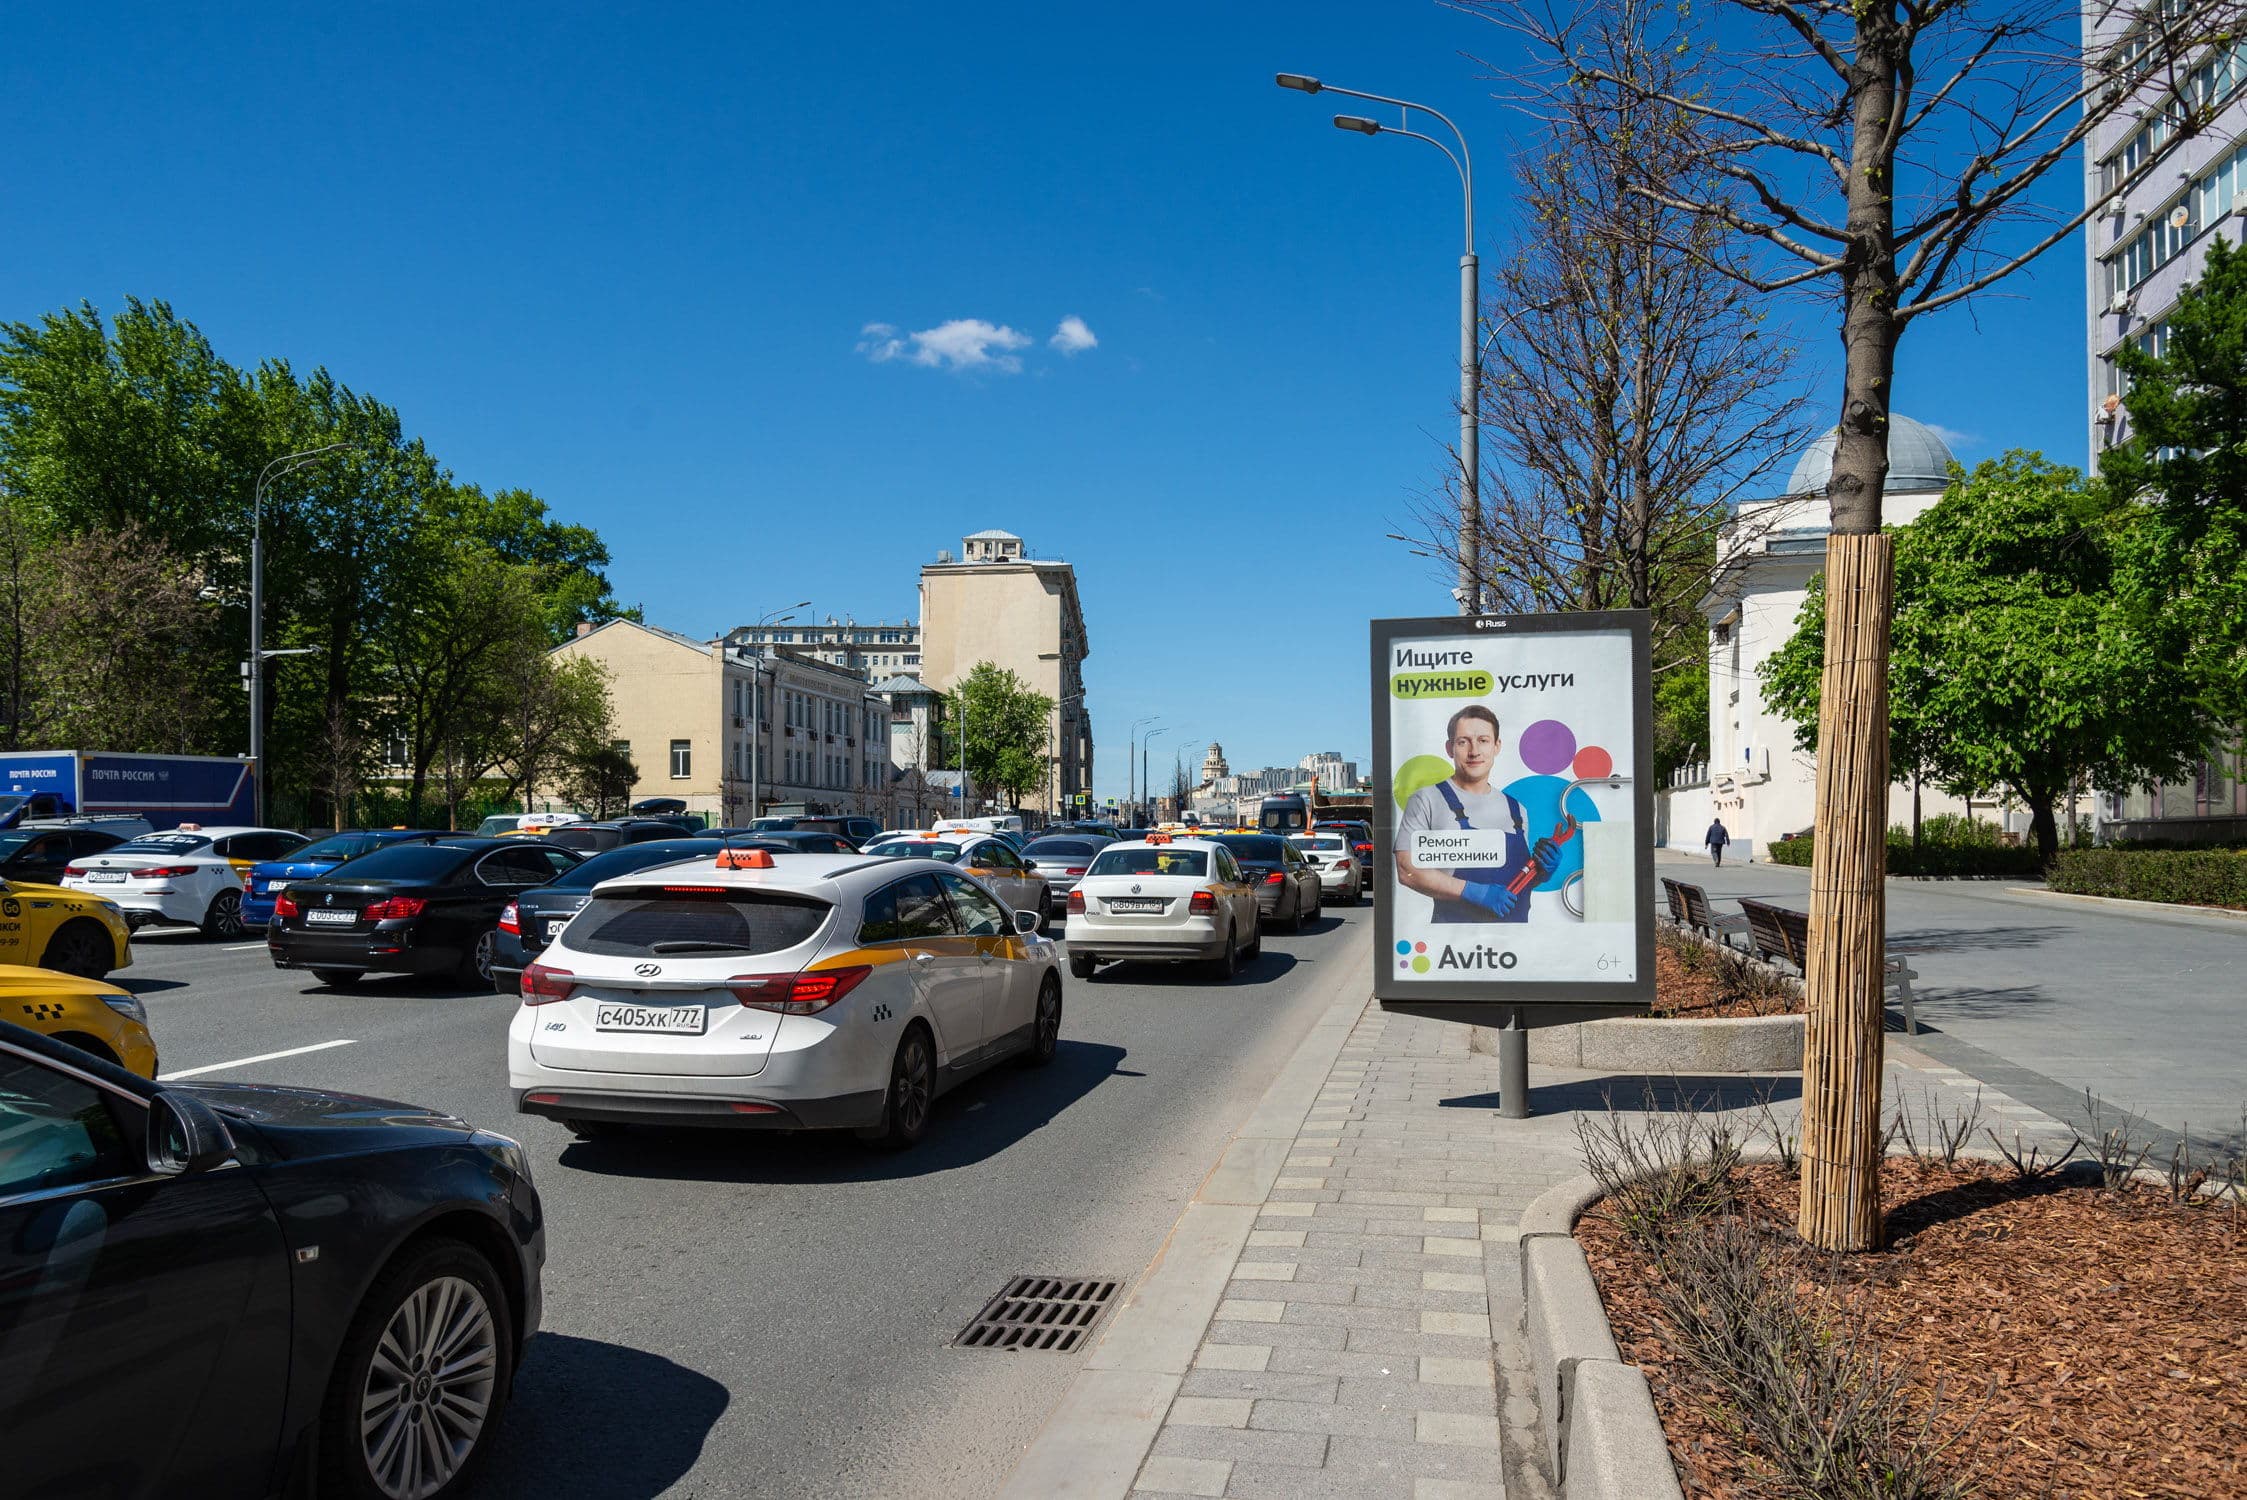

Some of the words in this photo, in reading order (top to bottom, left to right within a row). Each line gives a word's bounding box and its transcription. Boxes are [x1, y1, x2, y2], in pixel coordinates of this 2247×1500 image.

[1485, 619, 1507, 628] Russ
[1396, 648, 1473, 669] Ищите
[1396, 675, 1487, 696] нужные
[1498, 672, 1574, 693] услуги
[9, 770, 30, 779] ПОЧТА
[31, 769, 57, 778] РОССИИ
[92, 769, 119, 780] ПОЧТА
[122, 770, 155, 781] РОССИИ
[1418, 835, 1470, 848] Ремонт
[1418, 849, 1498, 862] сантехники
[4, 901, 19, 913] Go
[0, 922, 21, 931] КСИ
[1438, 944, 1517, 969] Avito
[1596, 953, 1622, 971] 6+
[673, 1009, 699, 1023] 777
